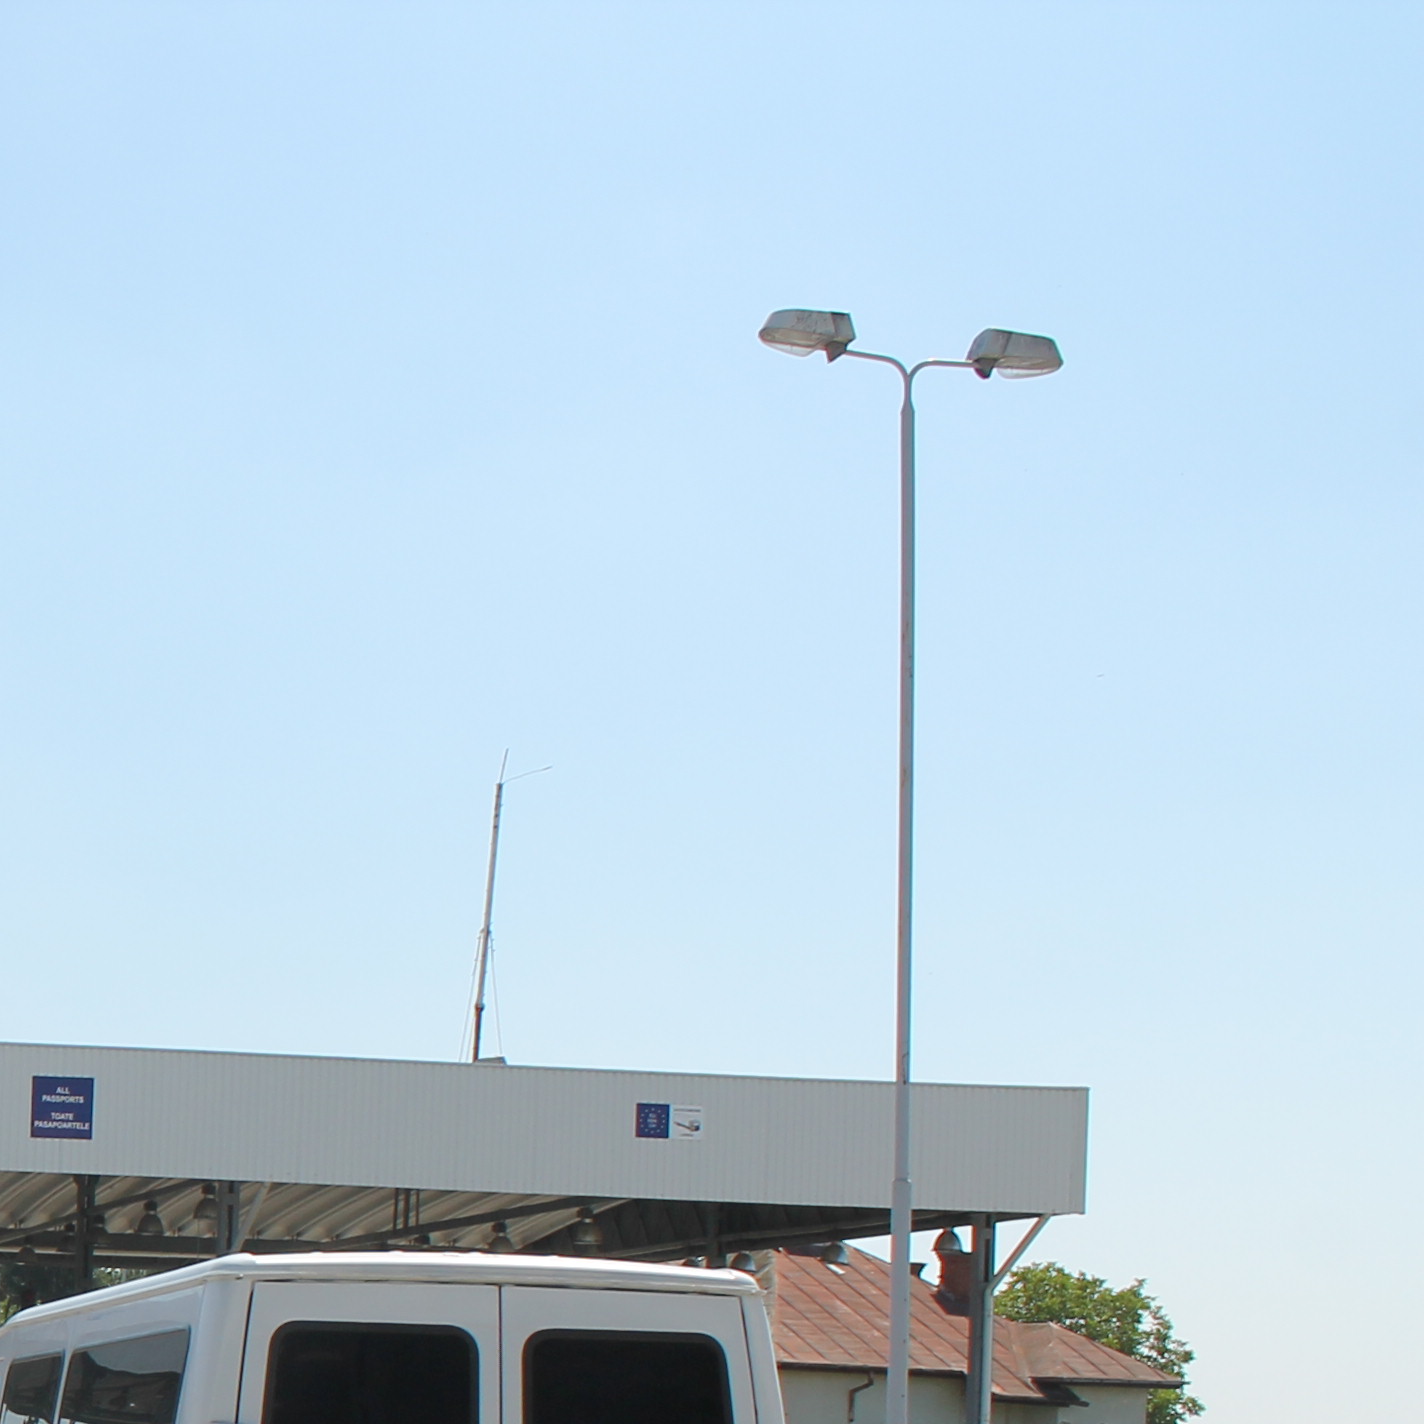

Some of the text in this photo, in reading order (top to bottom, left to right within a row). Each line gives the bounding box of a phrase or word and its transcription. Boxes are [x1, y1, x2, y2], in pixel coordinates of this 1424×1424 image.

[55, 1086, 70, 1094] ALL
[41, 1095, 84, 1104] PASSPORTS
[51, 1112, 74, 1120] TOATE
